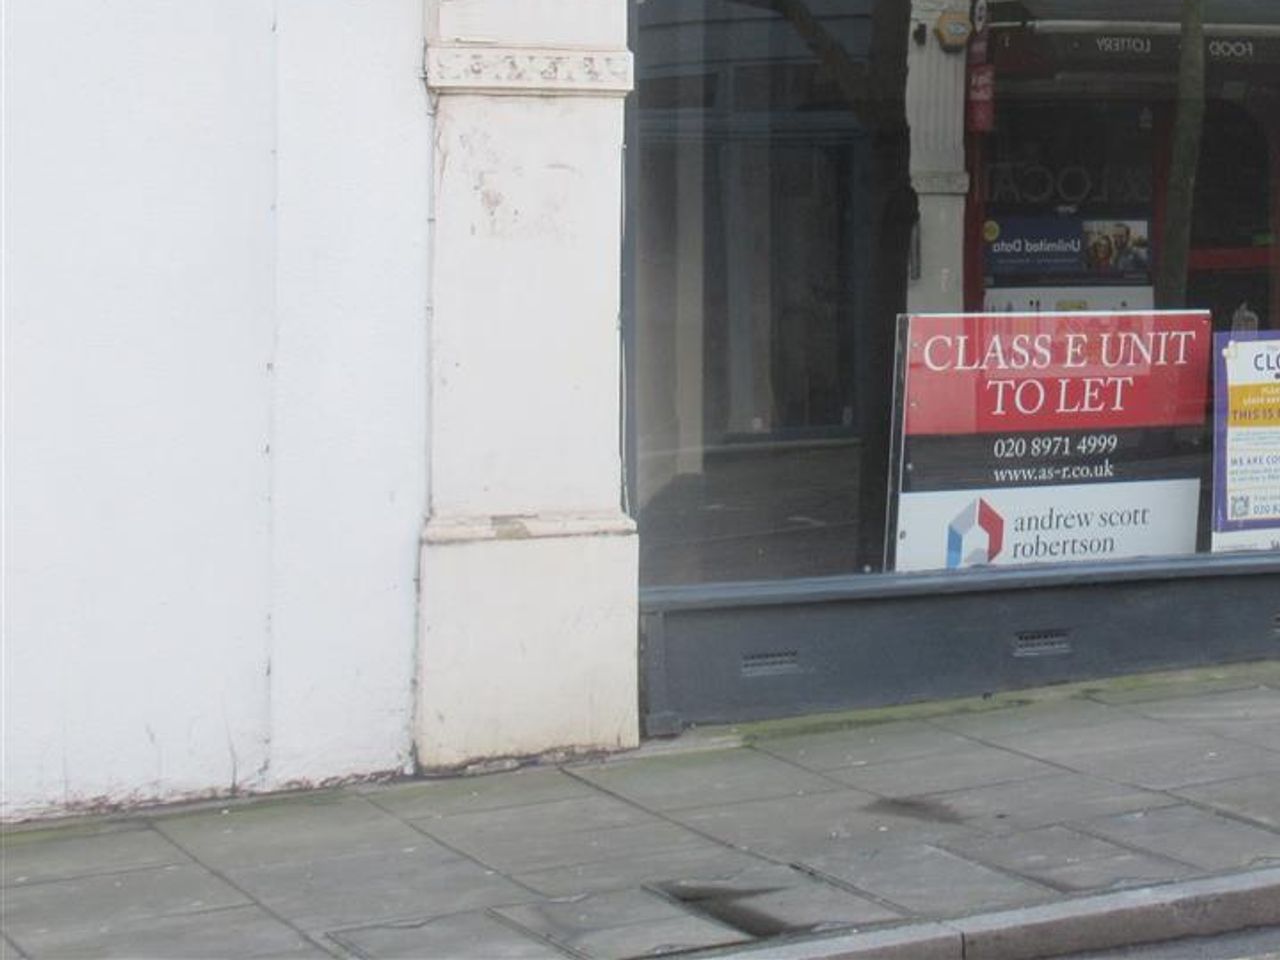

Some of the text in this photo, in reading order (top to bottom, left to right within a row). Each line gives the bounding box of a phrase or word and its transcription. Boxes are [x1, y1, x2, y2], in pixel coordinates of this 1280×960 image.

[923, 330, 1197, 372] CLASS E UNIT
[986, 375, 1134, 416] TO LET
[1232, 409, 1260, 421] THIS
[993, 434, 1118, 458] 020 8971 4999
[993, 458, 1115, 482] www.as-r.co.uk
[1246, 455, 1264, 465] ARE
[1014, 506, 1151, 532] andrew scott
[1012, 534, 1115, 559] robertson
